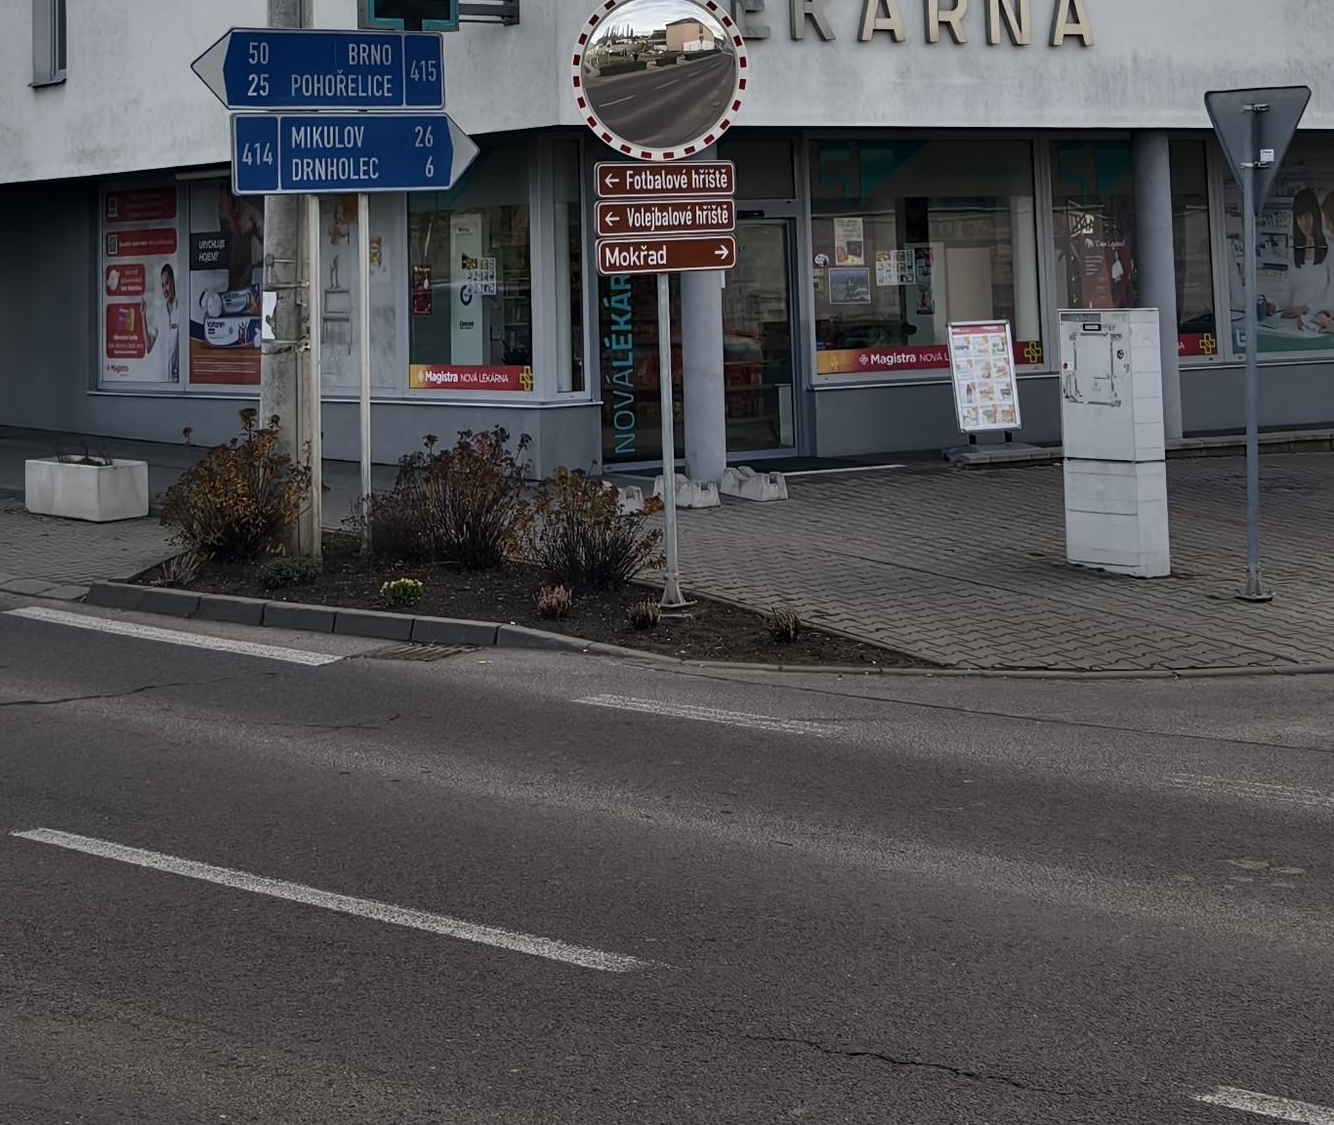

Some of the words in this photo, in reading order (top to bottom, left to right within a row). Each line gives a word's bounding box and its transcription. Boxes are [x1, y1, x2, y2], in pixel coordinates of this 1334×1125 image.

[249, 42, 269, 65] 50
[348, 43, 392, 66] BRNO
[247, 74, 269, 97] 25
[291, 68, 393, 97] POHOŘELICE
[410, 60, 436, 82] 415
[291, 126, 365, 149] MIKULOV
[415, 126, 433, 148] 26
[242, 142, 273, 166] 414
[292, 157, 379, 181] DRNHOLEC
[425, 156, 434, 178] 6
[626, 170, 688, 190] Fotbalové
[691, 167, 728, 189] hřiště
[627, 206, 692, 231] Volejbalové
[695, 203, 729, 225] hřiště
[605, 245, 667, 268] Mokřad
[870, 354, 917, 366] Magistra
[919, 353, 942, 363] NOVÁ
[425, 371, 459, 383] Magistra
[460, 373, 478, 382] NOVÁ
